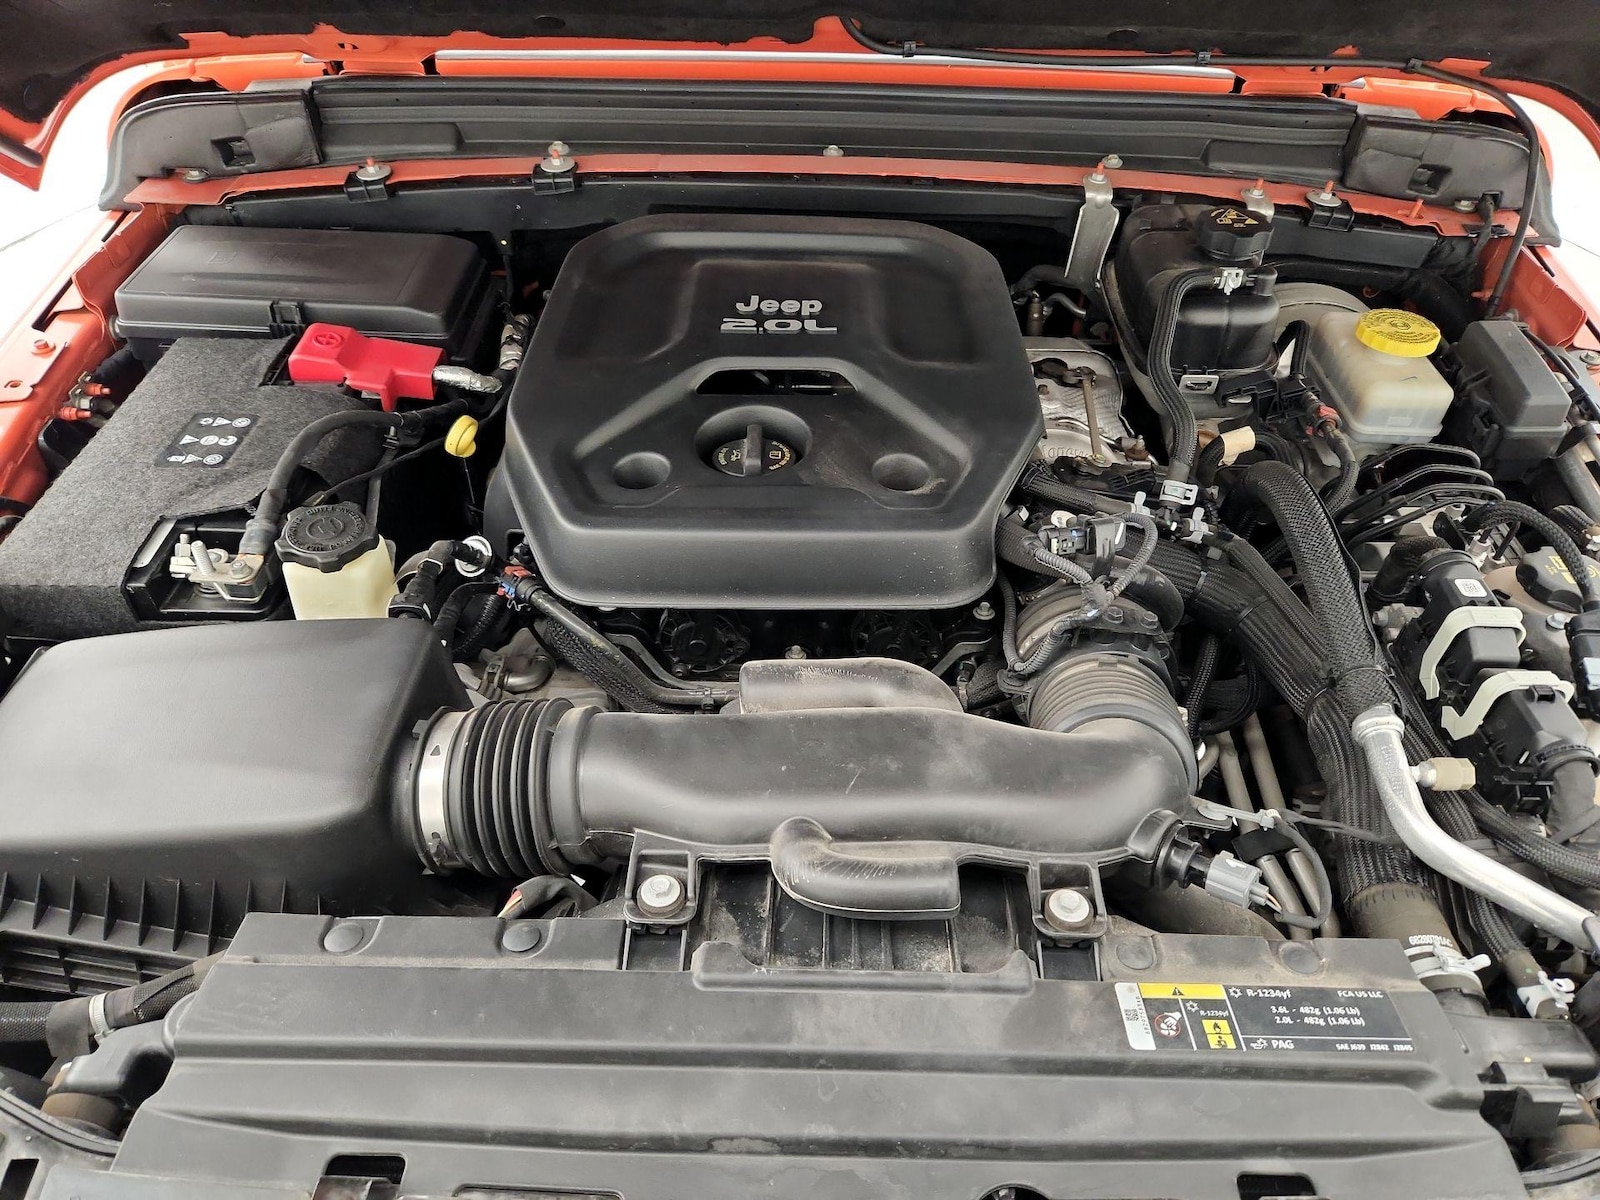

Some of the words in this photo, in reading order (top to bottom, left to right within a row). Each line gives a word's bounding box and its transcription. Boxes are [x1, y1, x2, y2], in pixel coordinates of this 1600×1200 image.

[736, 295, 823, 318] Jeep
[720, 317, 838, 334] 2.0L
[1246, 988, 1292, 999] R-1234yf
[1337, 990, 1355, 998] FCA
[1368, 991, 1384, 999] LLC
[1270, 1006, 1290, 1014] 3.6L
[1300, 1007, 1322, 1016] 482g
[1323, 1007, 1345, 1016] (1.06
[1275, 1016, 1294, 1024] 2.0L
[1304, 1017, 1326, 1027] 482g
[1328, 1017, 1350, 1027] (1.06
[1271, 1039, 1295, 1050] PAG
